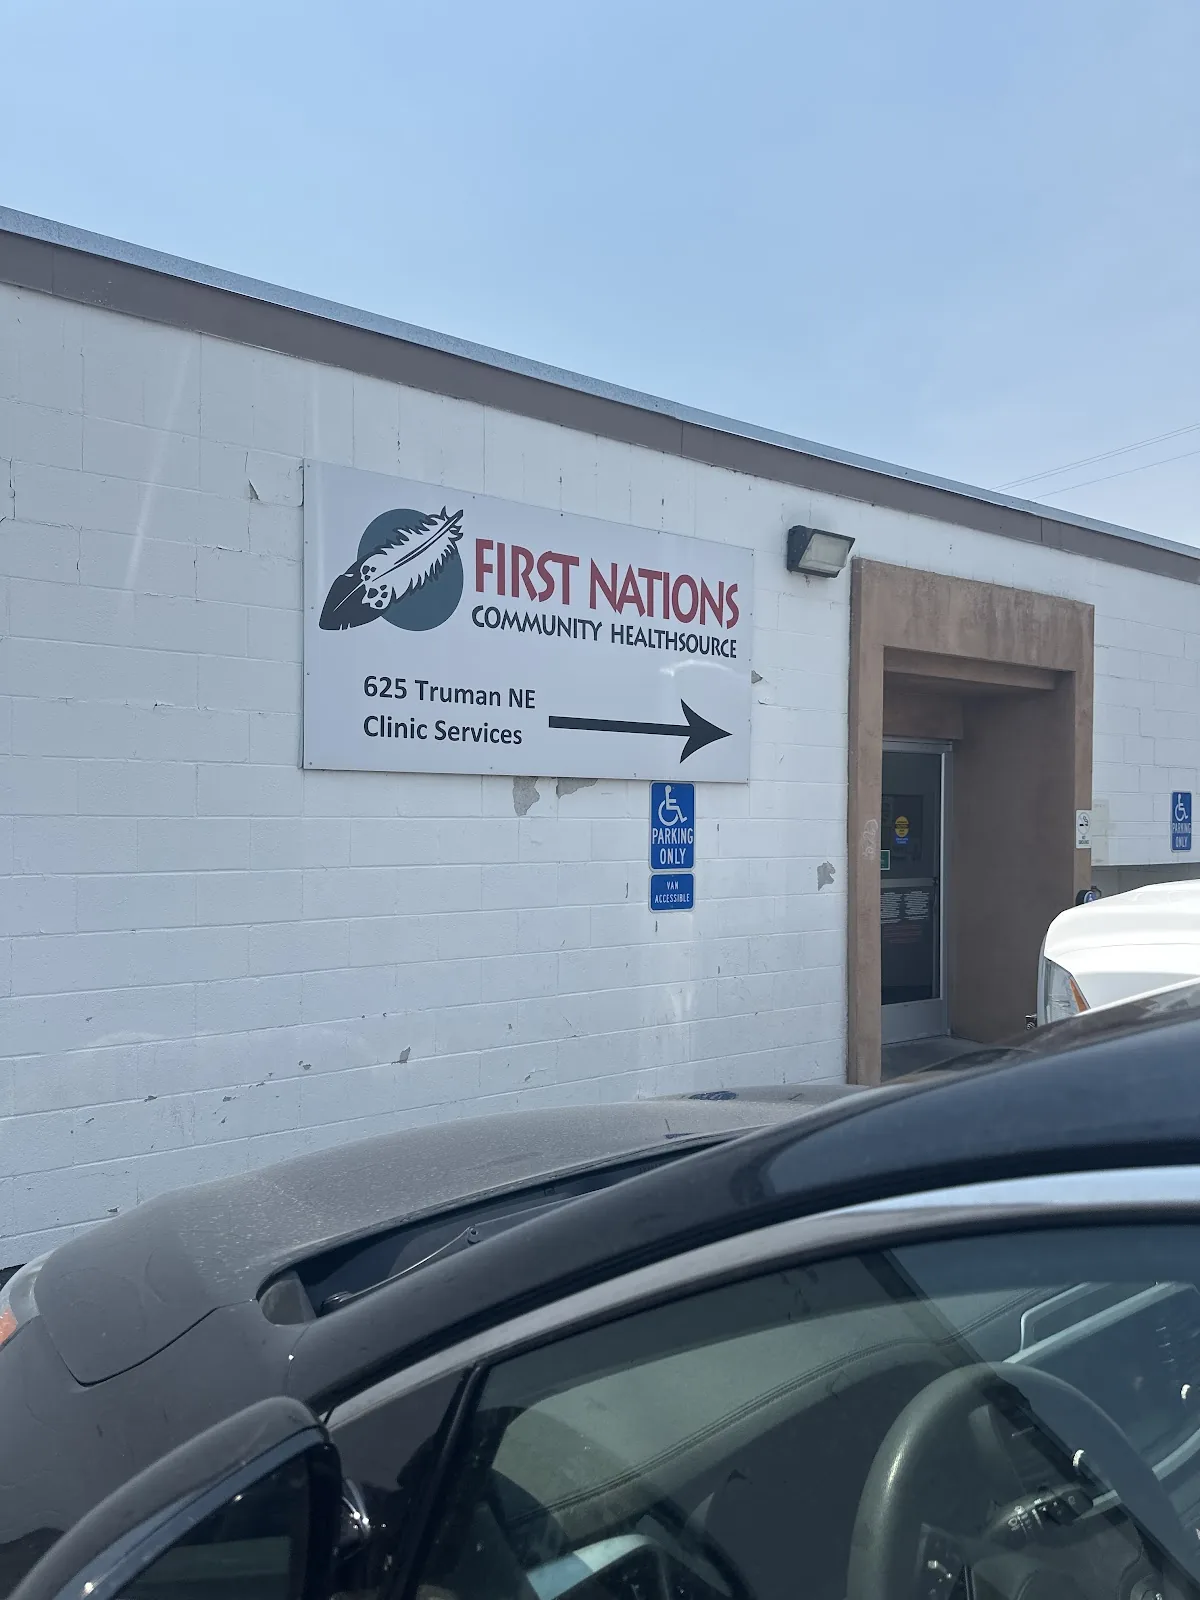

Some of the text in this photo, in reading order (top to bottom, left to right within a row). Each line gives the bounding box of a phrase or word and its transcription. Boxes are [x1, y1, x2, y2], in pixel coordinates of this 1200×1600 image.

[475, 538, 740, 629] FIRST NATIONS
[471, 605, 738, 658] COMMUNITY HEALTHSOURCE
[363, 675, 536, 709] 625 Truman NE
[363, 715, 523, 745] Clinic Services
[652, 828, 694, 844] PARKING
[660, 848, 686, 864] ONLY
[666, 881, 679, 890] VAN
[654, 893, 690, 903] ACCESSIBLE
